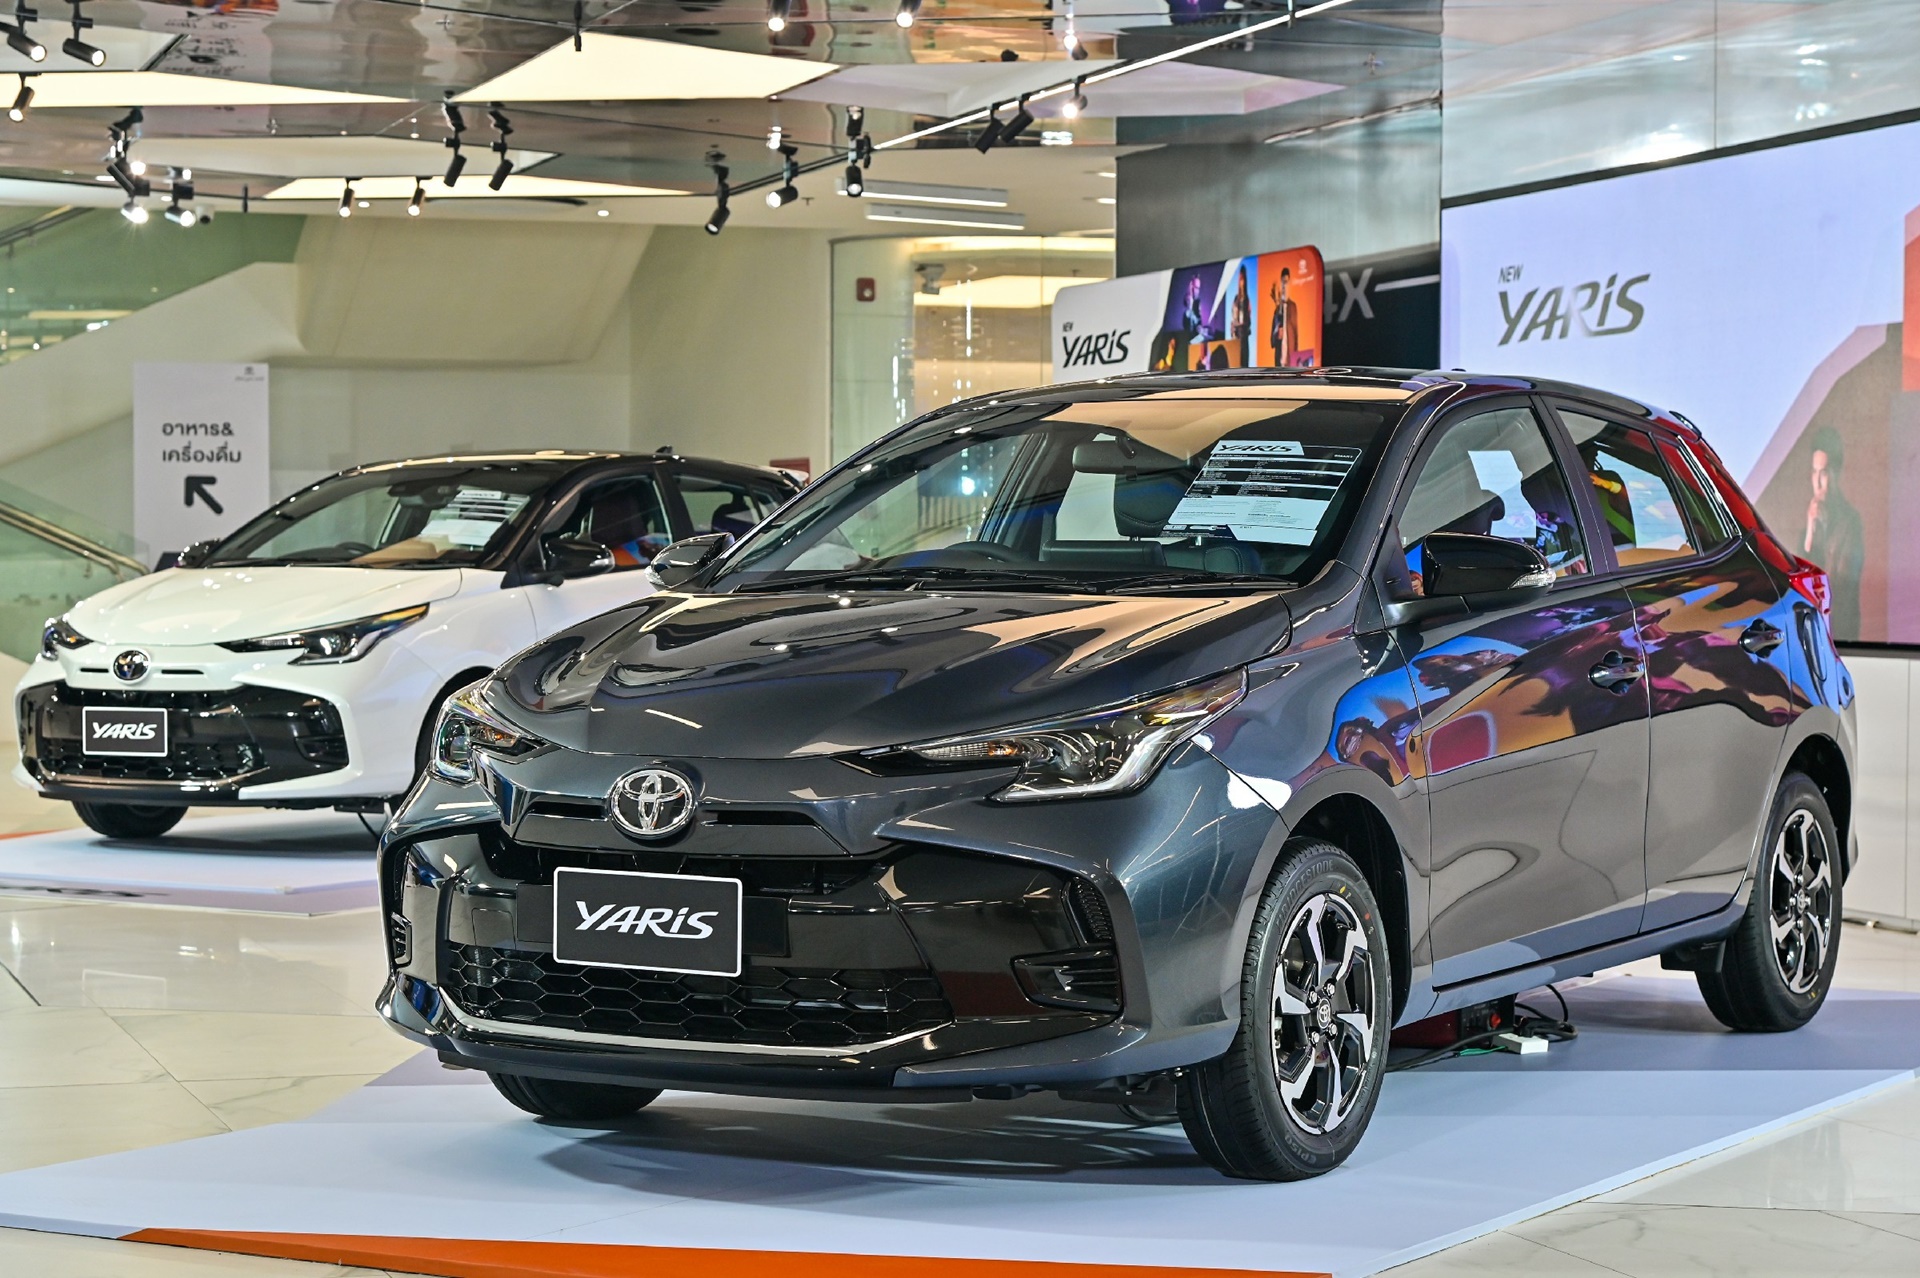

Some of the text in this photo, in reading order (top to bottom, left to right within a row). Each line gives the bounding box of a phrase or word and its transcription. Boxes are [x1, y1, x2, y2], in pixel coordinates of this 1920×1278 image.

[1499, 264, 1523, 283] NEW
[161, 421, 234, 437] อาหาร&
[161, 440, 242, 464] เครื่องดื่ม
